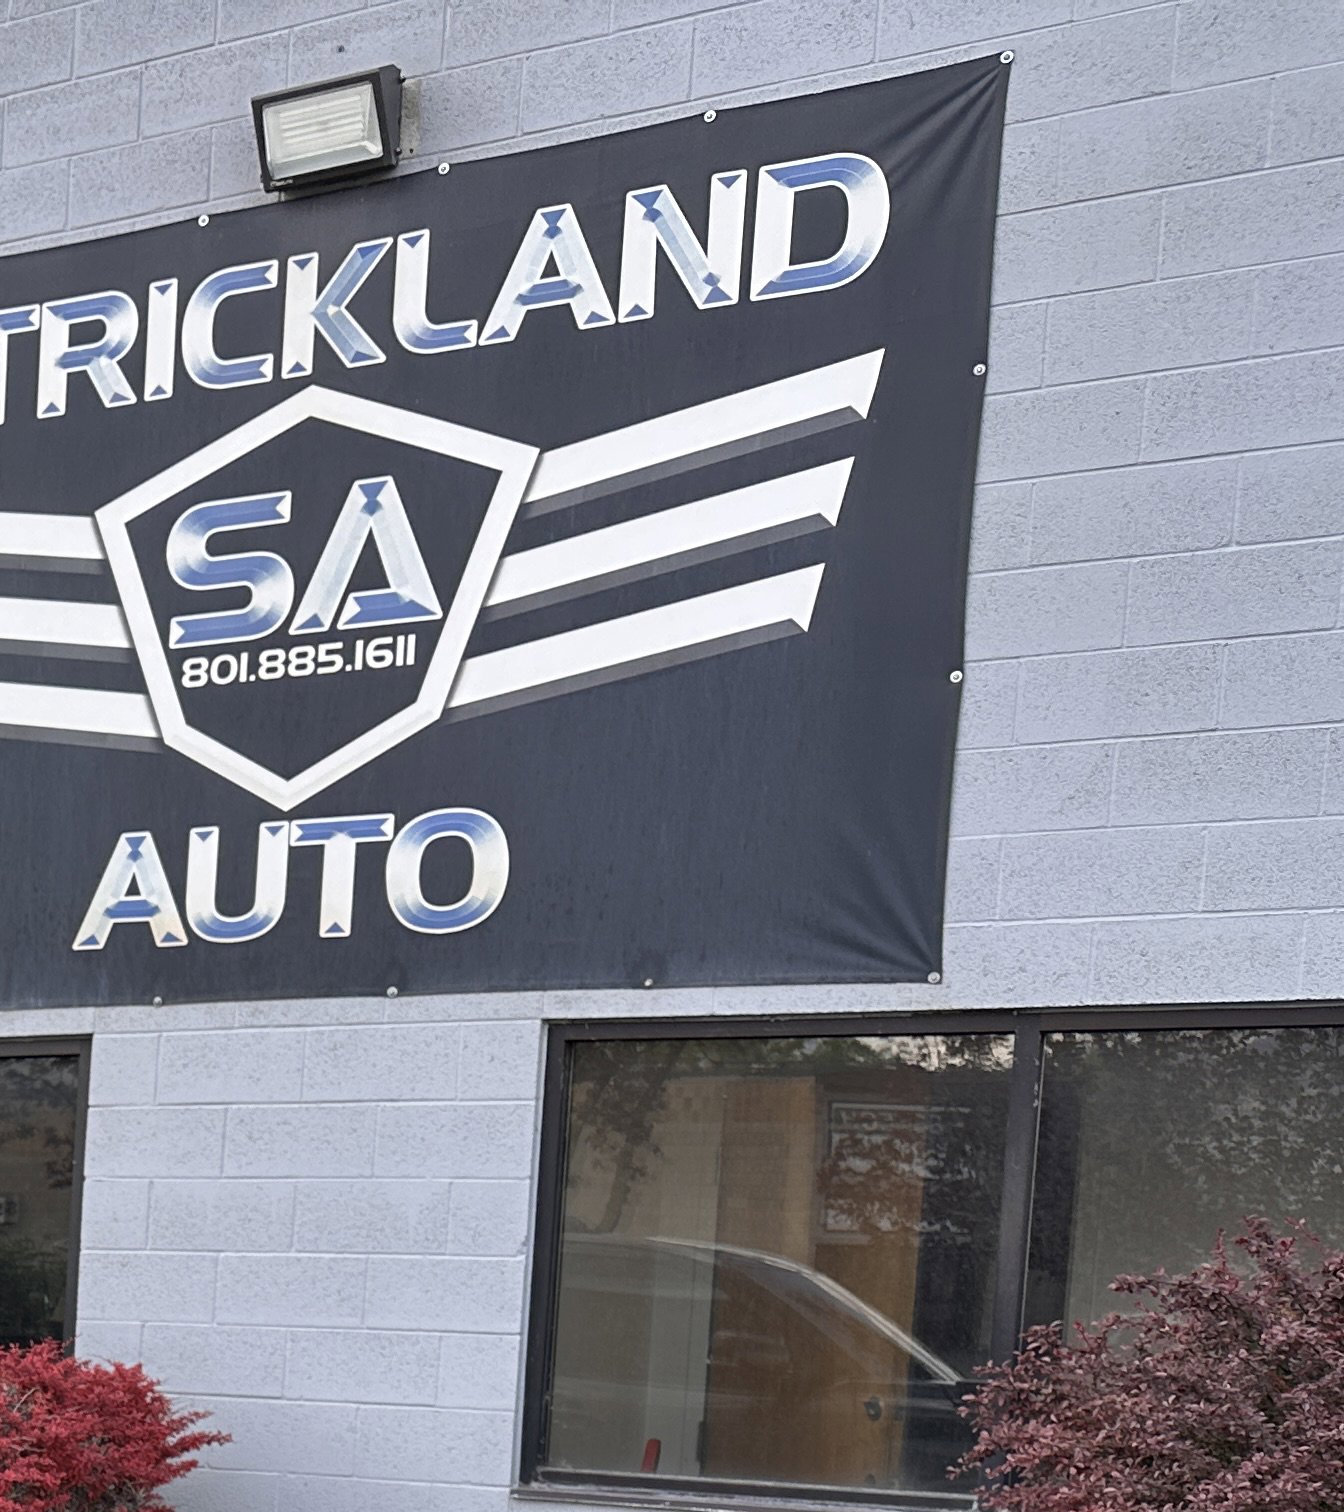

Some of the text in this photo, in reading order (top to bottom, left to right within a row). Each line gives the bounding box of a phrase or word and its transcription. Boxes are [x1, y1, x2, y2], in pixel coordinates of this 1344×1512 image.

[165, 474, 443, 649] SA
[179, 634, 417, 690] 801.885.1611
[72, 805, 511, 952] AUTO
